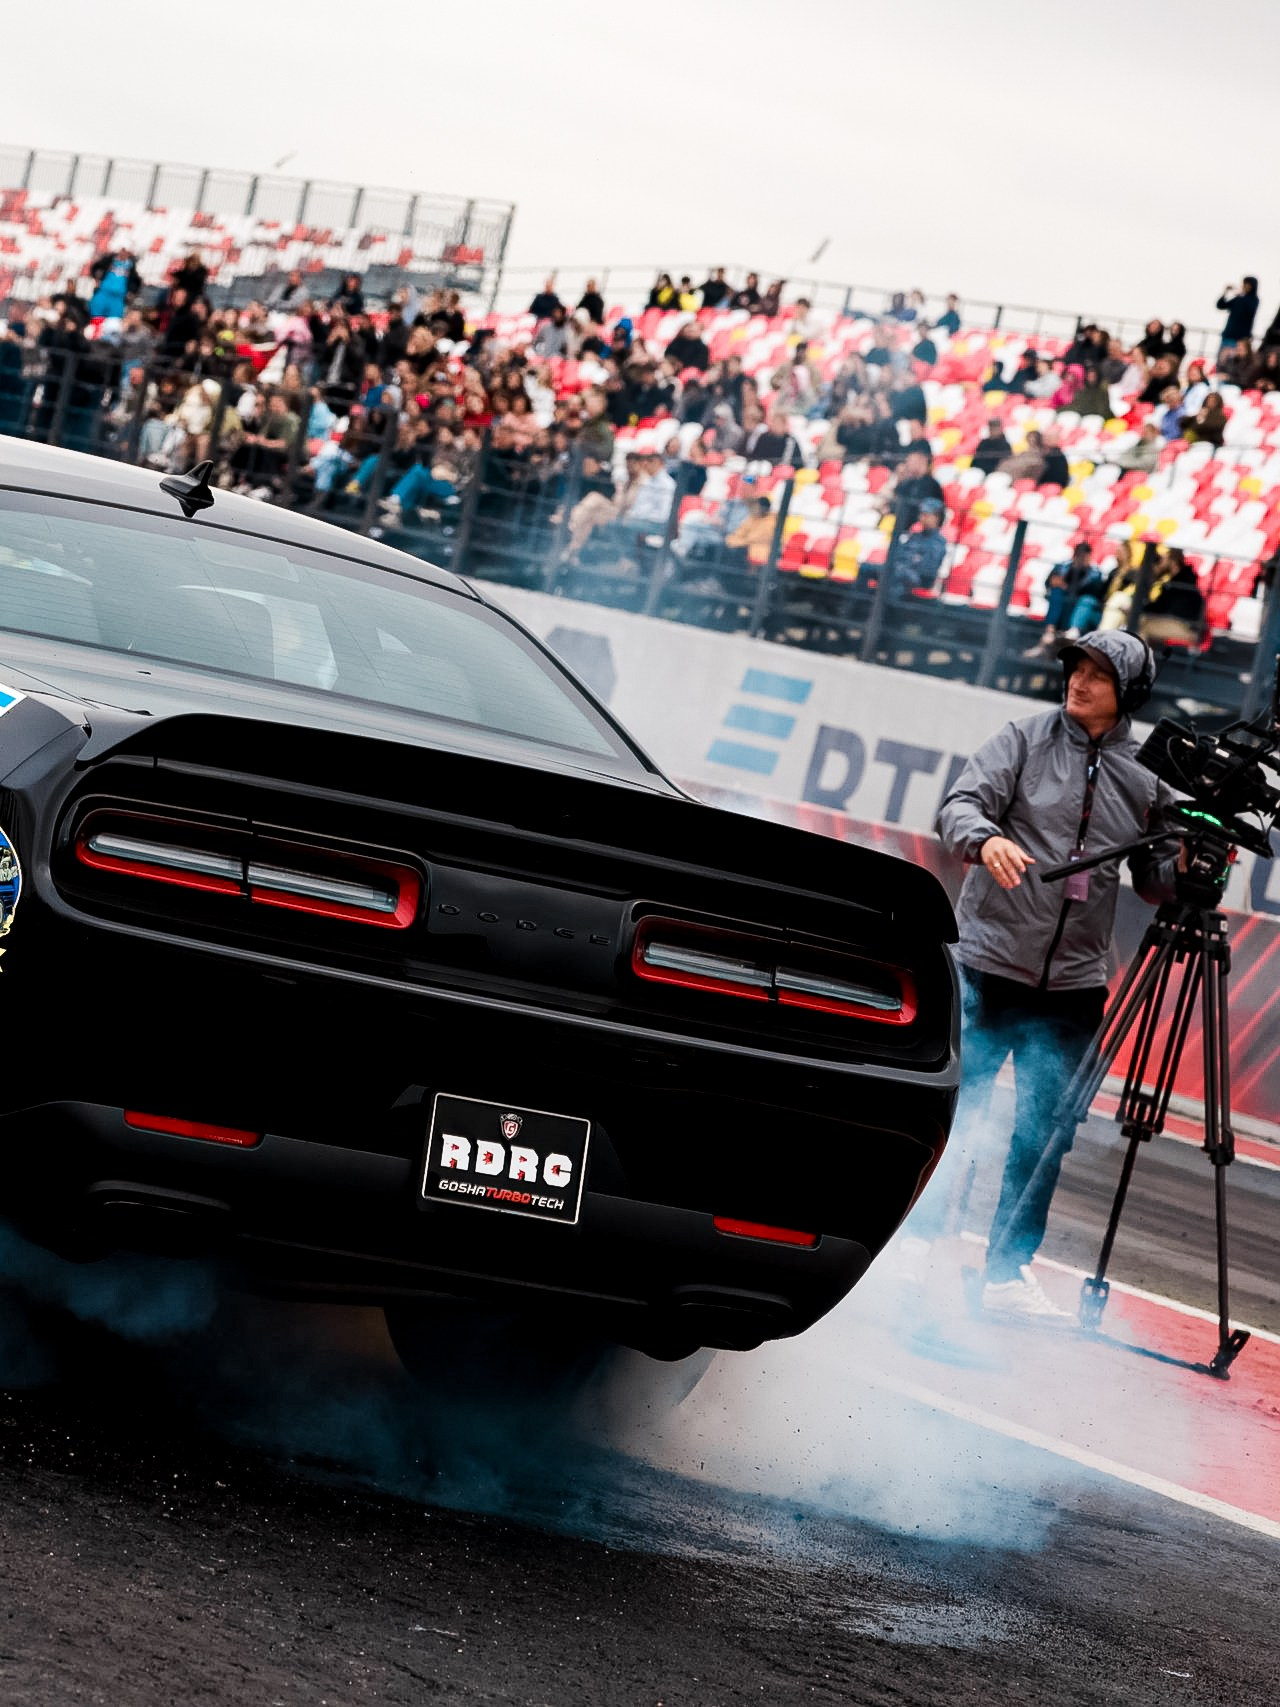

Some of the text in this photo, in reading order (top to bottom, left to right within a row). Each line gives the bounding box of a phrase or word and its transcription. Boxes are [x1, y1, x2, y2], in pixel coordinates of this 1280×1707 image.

[437, 903, 611, 946] DODGE
[440, 1134, 573, 1188] RDRC
[439, 1180, 565, 1211] GOSHATURBOTECH
